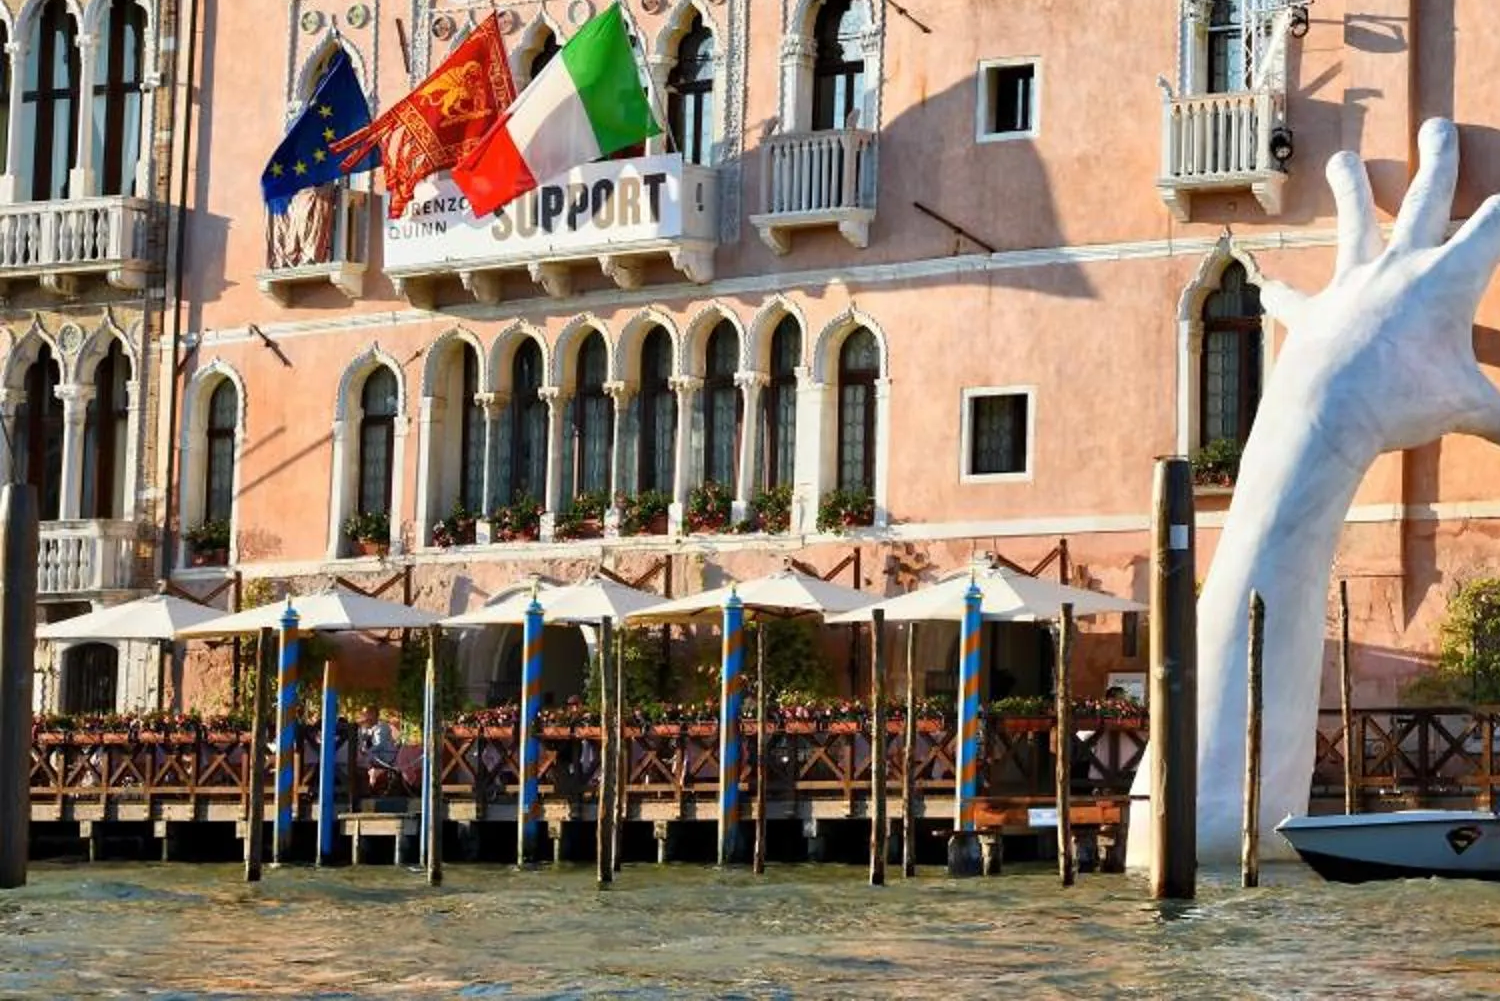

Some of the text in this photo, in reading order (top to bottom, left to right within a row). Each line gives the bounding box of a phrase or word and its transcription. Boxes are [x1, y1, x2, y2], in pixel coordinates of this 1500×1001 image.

[402, 196, 471, 217] RENZO
[492, 173, 666, 241] SUPPORT
[389, 221, 448, 241] QUINN
